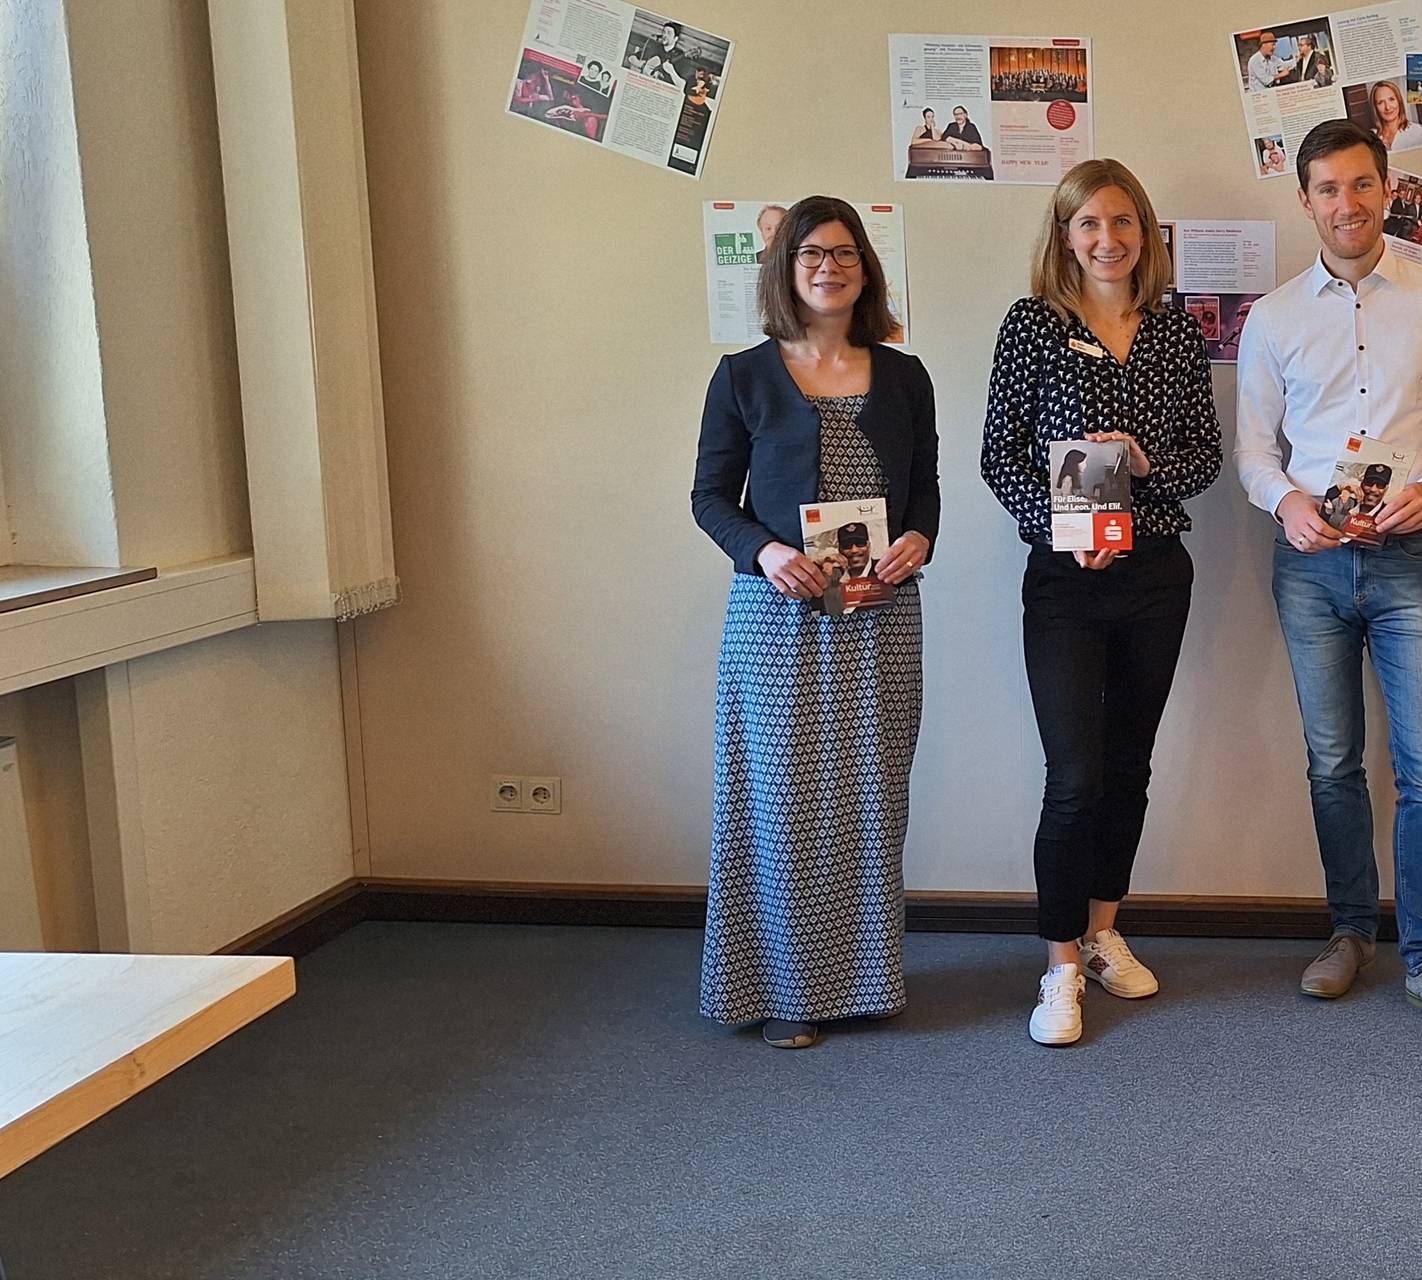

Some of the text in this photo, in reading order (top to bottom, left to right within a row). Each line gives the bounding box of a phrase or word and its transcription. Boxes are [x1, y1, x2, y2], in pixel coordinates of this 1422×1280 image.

[716, 246, 734, 255] DER
[718, 254, 753, 264] GEIZIGE
[1053, 495, 1066, 503] Für
[1054, 503, 1069, 511] Und
[1070, 503, 1090, 511] Leon.
[1350, 517, 1373, 529] Kultur
[845, 583, 872, 593] Kultur
